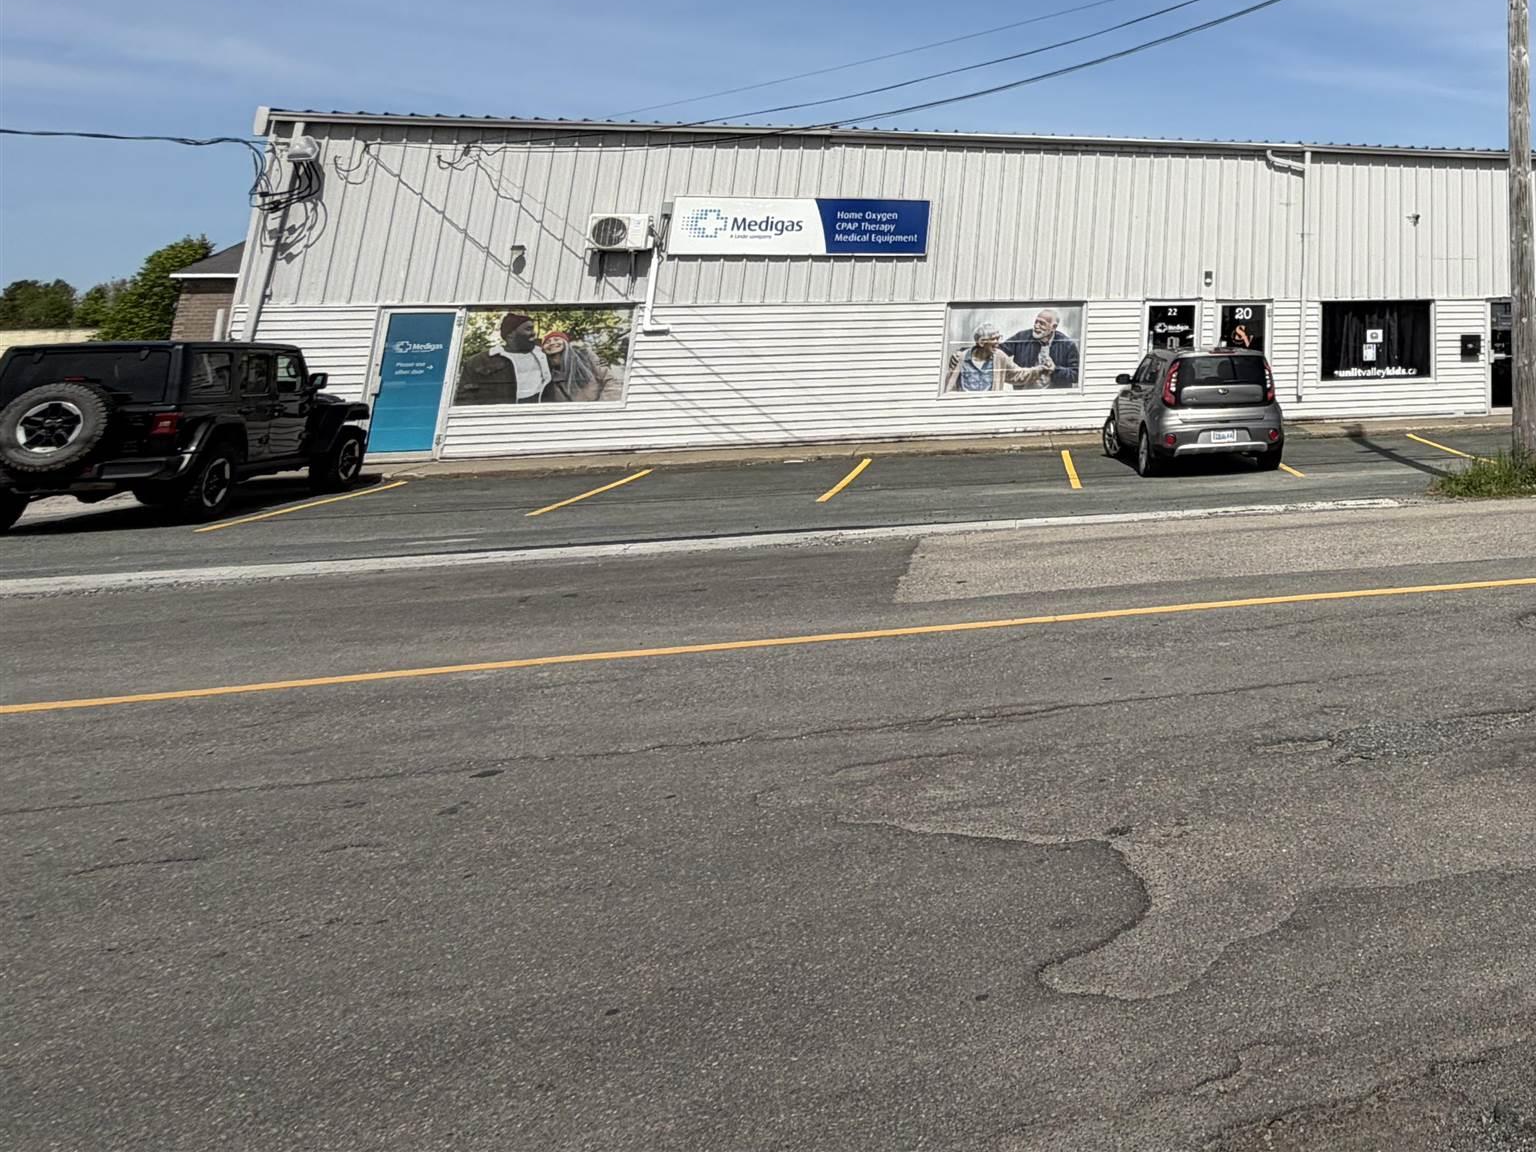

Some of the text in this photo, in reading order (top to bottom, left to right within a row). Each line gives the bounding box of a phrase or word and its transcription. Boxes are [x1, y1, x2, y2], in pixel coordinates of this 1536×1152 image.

[837, 211, 898, 222] Home Oxygen
[730, 216, 803, 236] Medigas
[835, 222, 896, 232] CPAP Therapy
[834, 233, 918, 244] Medical Equipment
[1167, 308, 1179, 317] 22
[1234, 307, 1253, 320] 20
